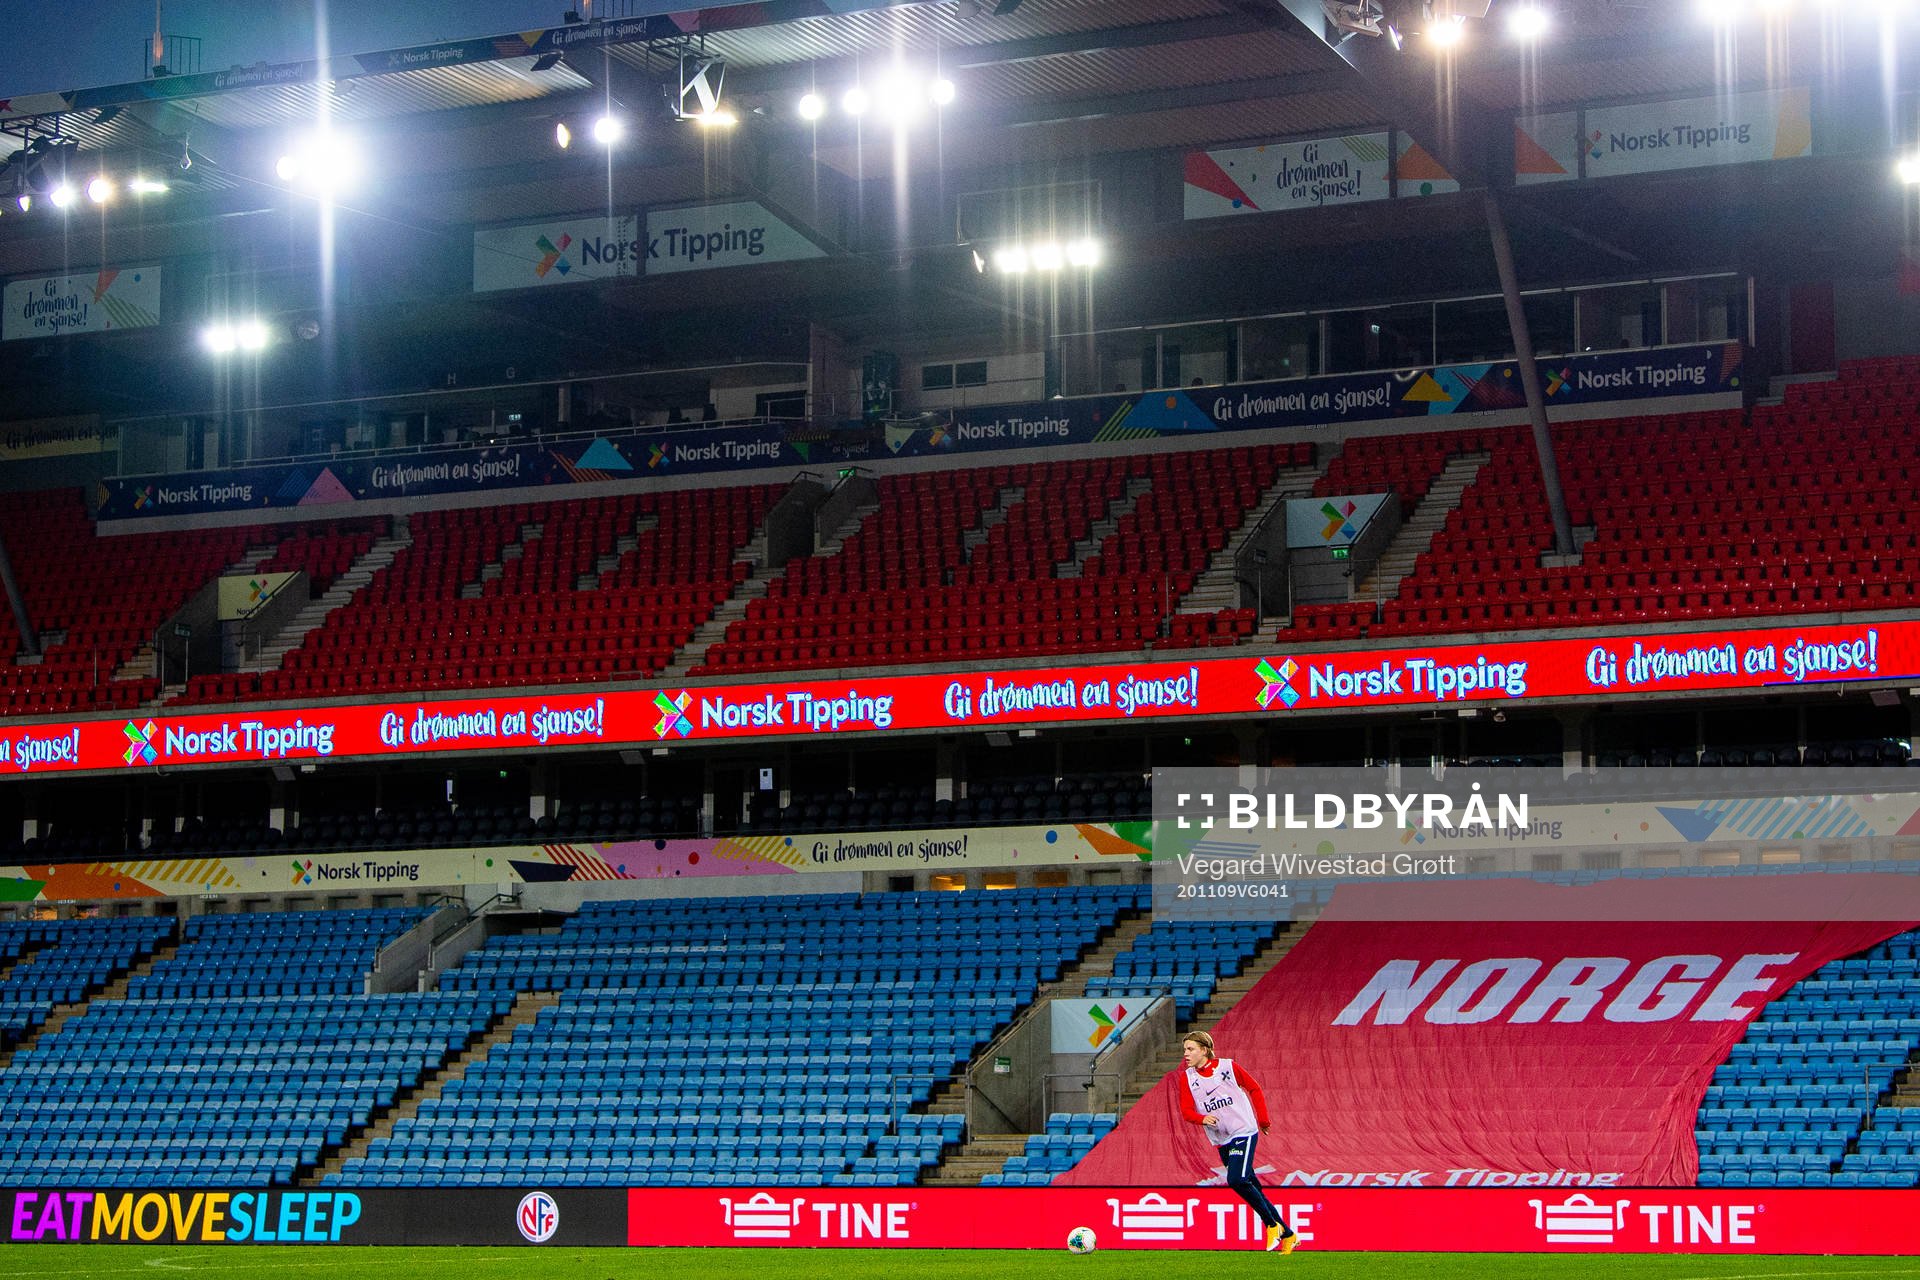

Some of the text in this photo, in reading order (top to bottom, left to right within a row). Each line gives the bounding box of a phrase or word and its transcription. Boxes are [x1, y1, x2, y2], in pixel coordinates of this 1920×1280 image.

[552, 31, 563, 45] Gi
[603, 25, 614, 37] en
[615, 19, 648, 37] sjanse!
[404, 48, 464, 63] Norsk Tipping
[1610, 121, 1751, 152] Norsk Tipping
[1303, 143, 1319, 164] Gi
[1276, 157, 1349, 189] drømmen
[1291, 169, 1362, 205] en sjanse!
[582, 223, 766, 266] Norsk Tipping
[44, 279, 57, 297] Gi
[23, 291, 79, 320] drømmen
[34, 303, 88, 336] en sjanse!
[1578, 363, 1706, 389] Norsk Tipping
[1213, 381, 1392, 421] Gi drømmen en sjanse!
[957, 416, 1070, 440] Norsk Tipping
[675, 439, 780, 462] Norsk Tipping
[372, 453, 521, 489] Gi drømmen en sjanse!
[158, 483, 253, 504] Norsk Tipping
[1586, 628, 1878, 688] Gi drømmen en sjanse!
[944, 666, 1199, 719] Gi drømmen en sjanse!
[1309, 655, 1529, 700] Norsk Tipping
[380, 697, 605, 748] Gi drømmen en sjanse!
[701, 688, 895, 731] Norsk Tipping
[15, 727, 81, 771] sjanse!
[165, 718, 335, 759] Norsk Tipping
[812, 834, 968, 864] Gi drømmen en sjanse!
[317, 860, 420, 882] Norsk Tipping
[1330, 951, 1800, 1026] NORGE
[1280, 1168, 1624, 1187] Norsk Tipping
[812, 1203, 910, 1239] TINE
[1639, 1205, 1756, 1244] TINE
